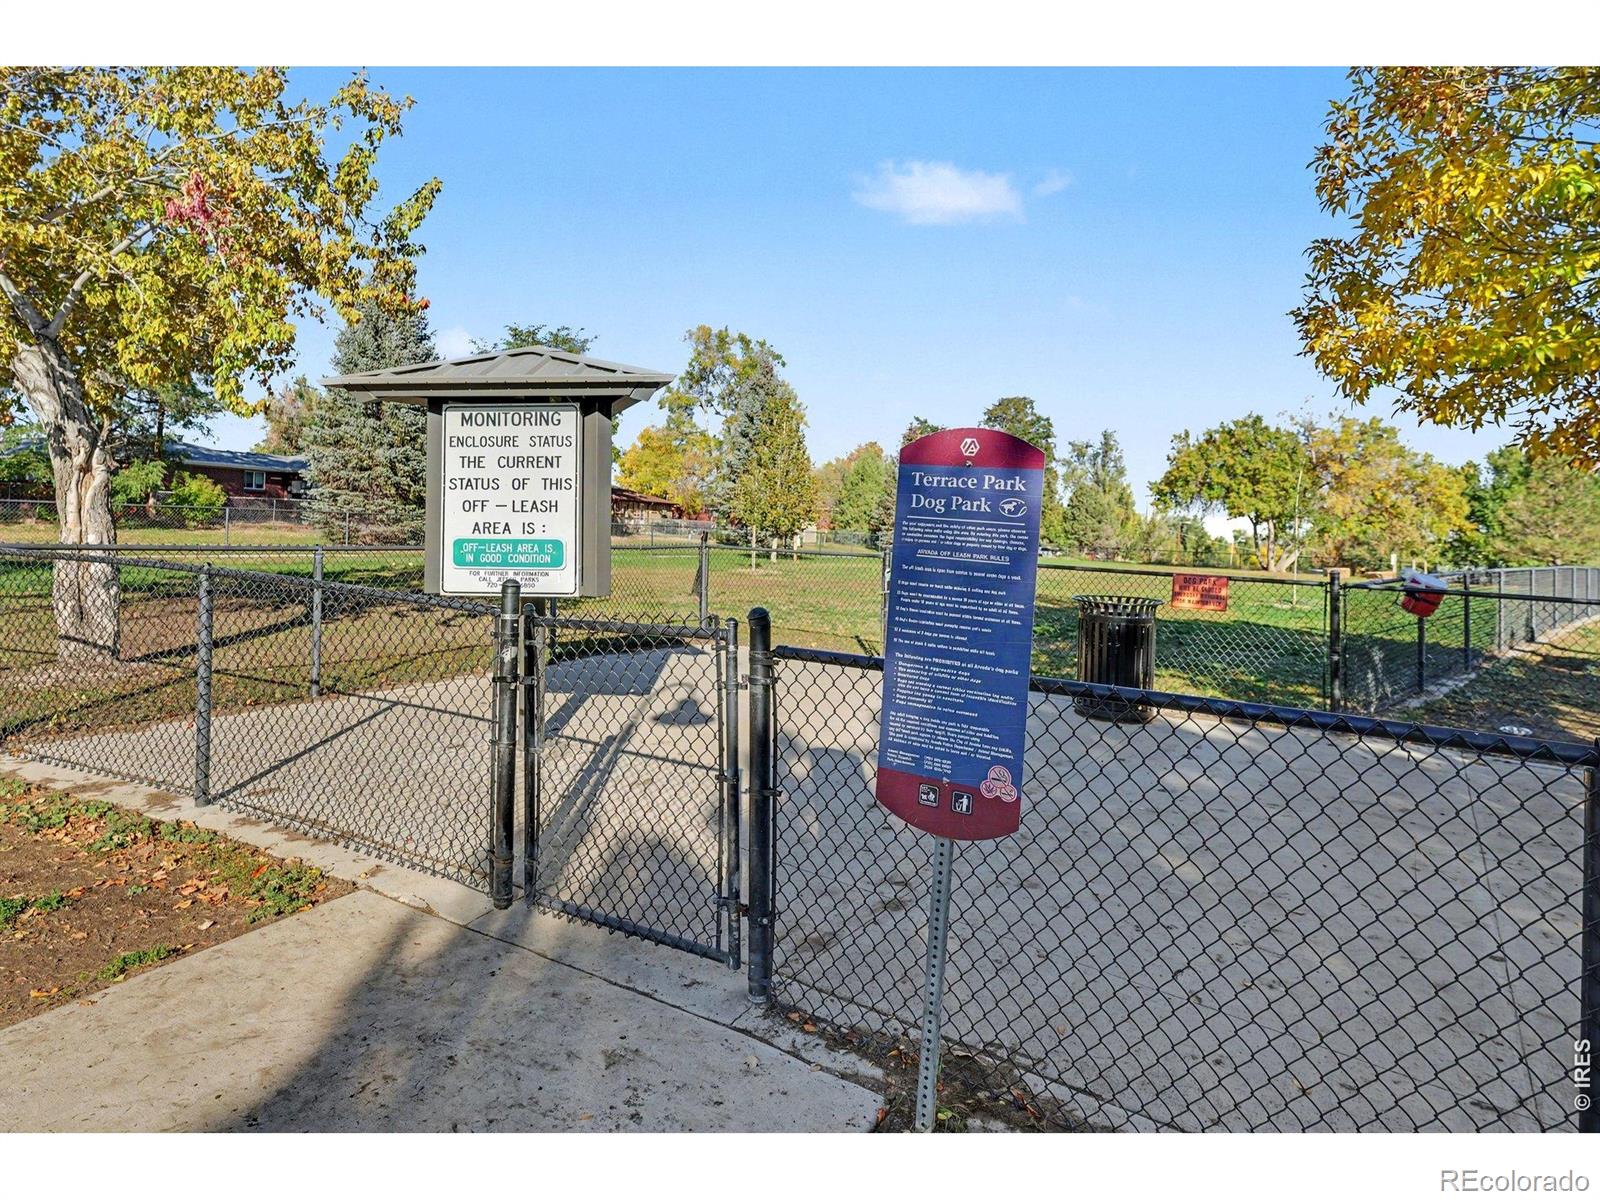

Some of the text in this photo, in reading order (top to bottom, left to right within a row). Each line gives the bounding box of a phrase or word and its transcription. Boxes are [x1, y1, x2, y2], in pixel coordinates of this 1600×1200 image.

[461, 411, 561, 427] MONITORING
[449, 436, 572, 447] ENCLOSURE STATUS
[459, 456, 562, 468] THE CURRENT
[449, 478, 572, 490] STATUS OF THIS
[912, 471, 1027, 491] Terrace Park
[462, 500, 489, 513] OFF
[512, 500, 558, 513] LEASH
[911, 494, 992, 513] Dog Park
[472, 522, 511, 535] AREA
[463, 543, 553, 553] OFF-LEASH AREA IS
[465, 553, 551, 563] IN GOOD CONDITION
